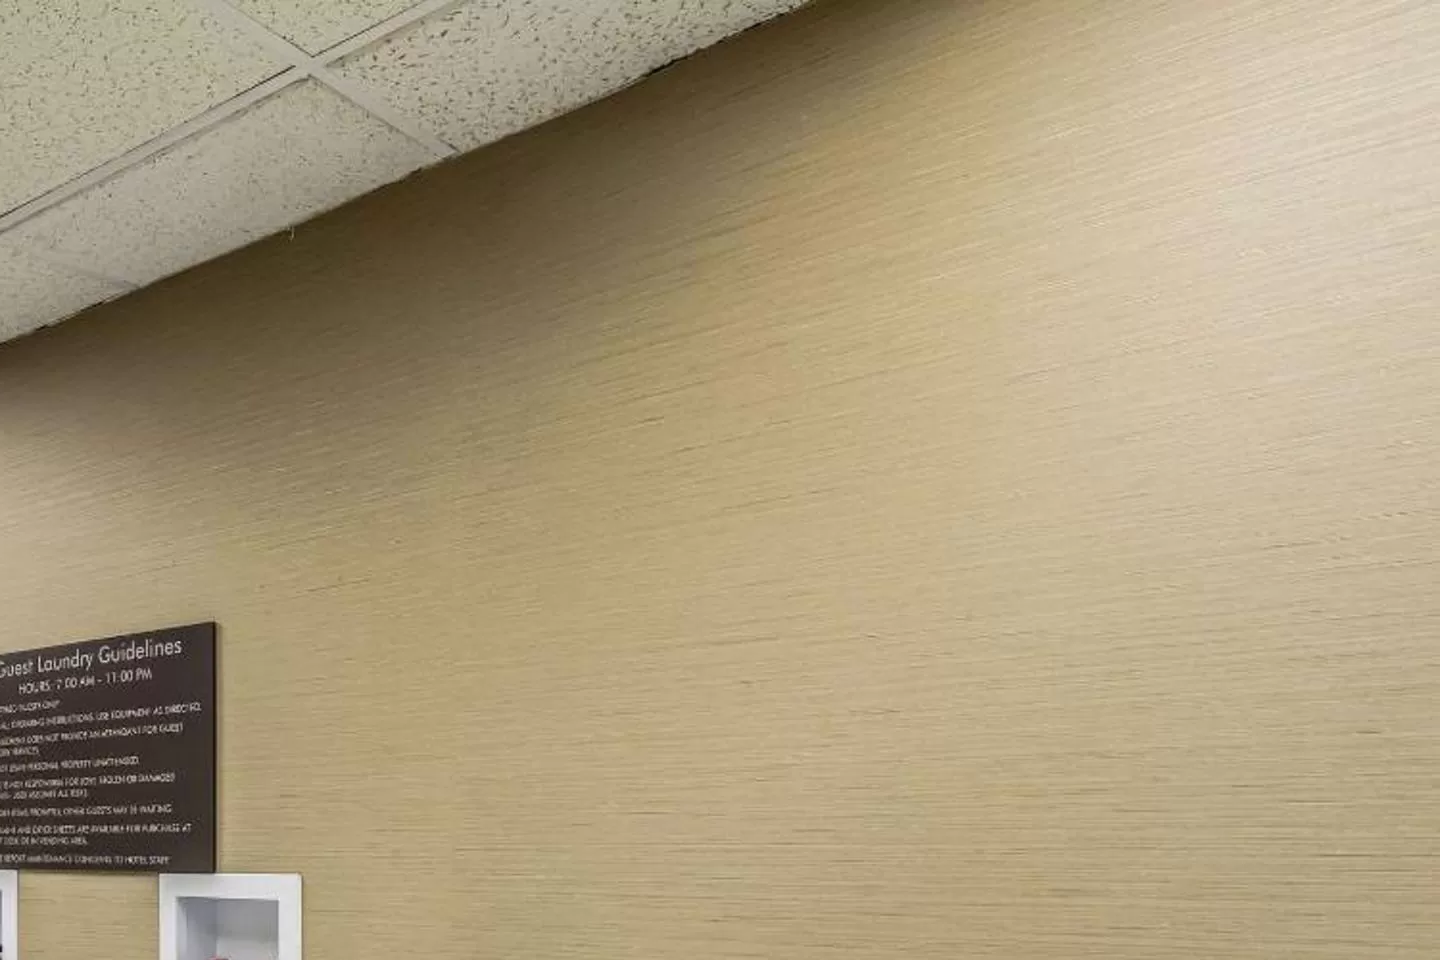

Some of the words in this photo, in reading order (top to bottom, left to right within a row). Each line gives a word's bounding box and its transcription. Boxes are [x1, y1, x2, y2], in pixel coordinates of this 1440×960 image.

[37, 648, 93, 672] Laundry
[98, 639, 182, 664] Guidelines
[105, 668, 134, 684] 11:00
[135, 666, 153, 681] PM
